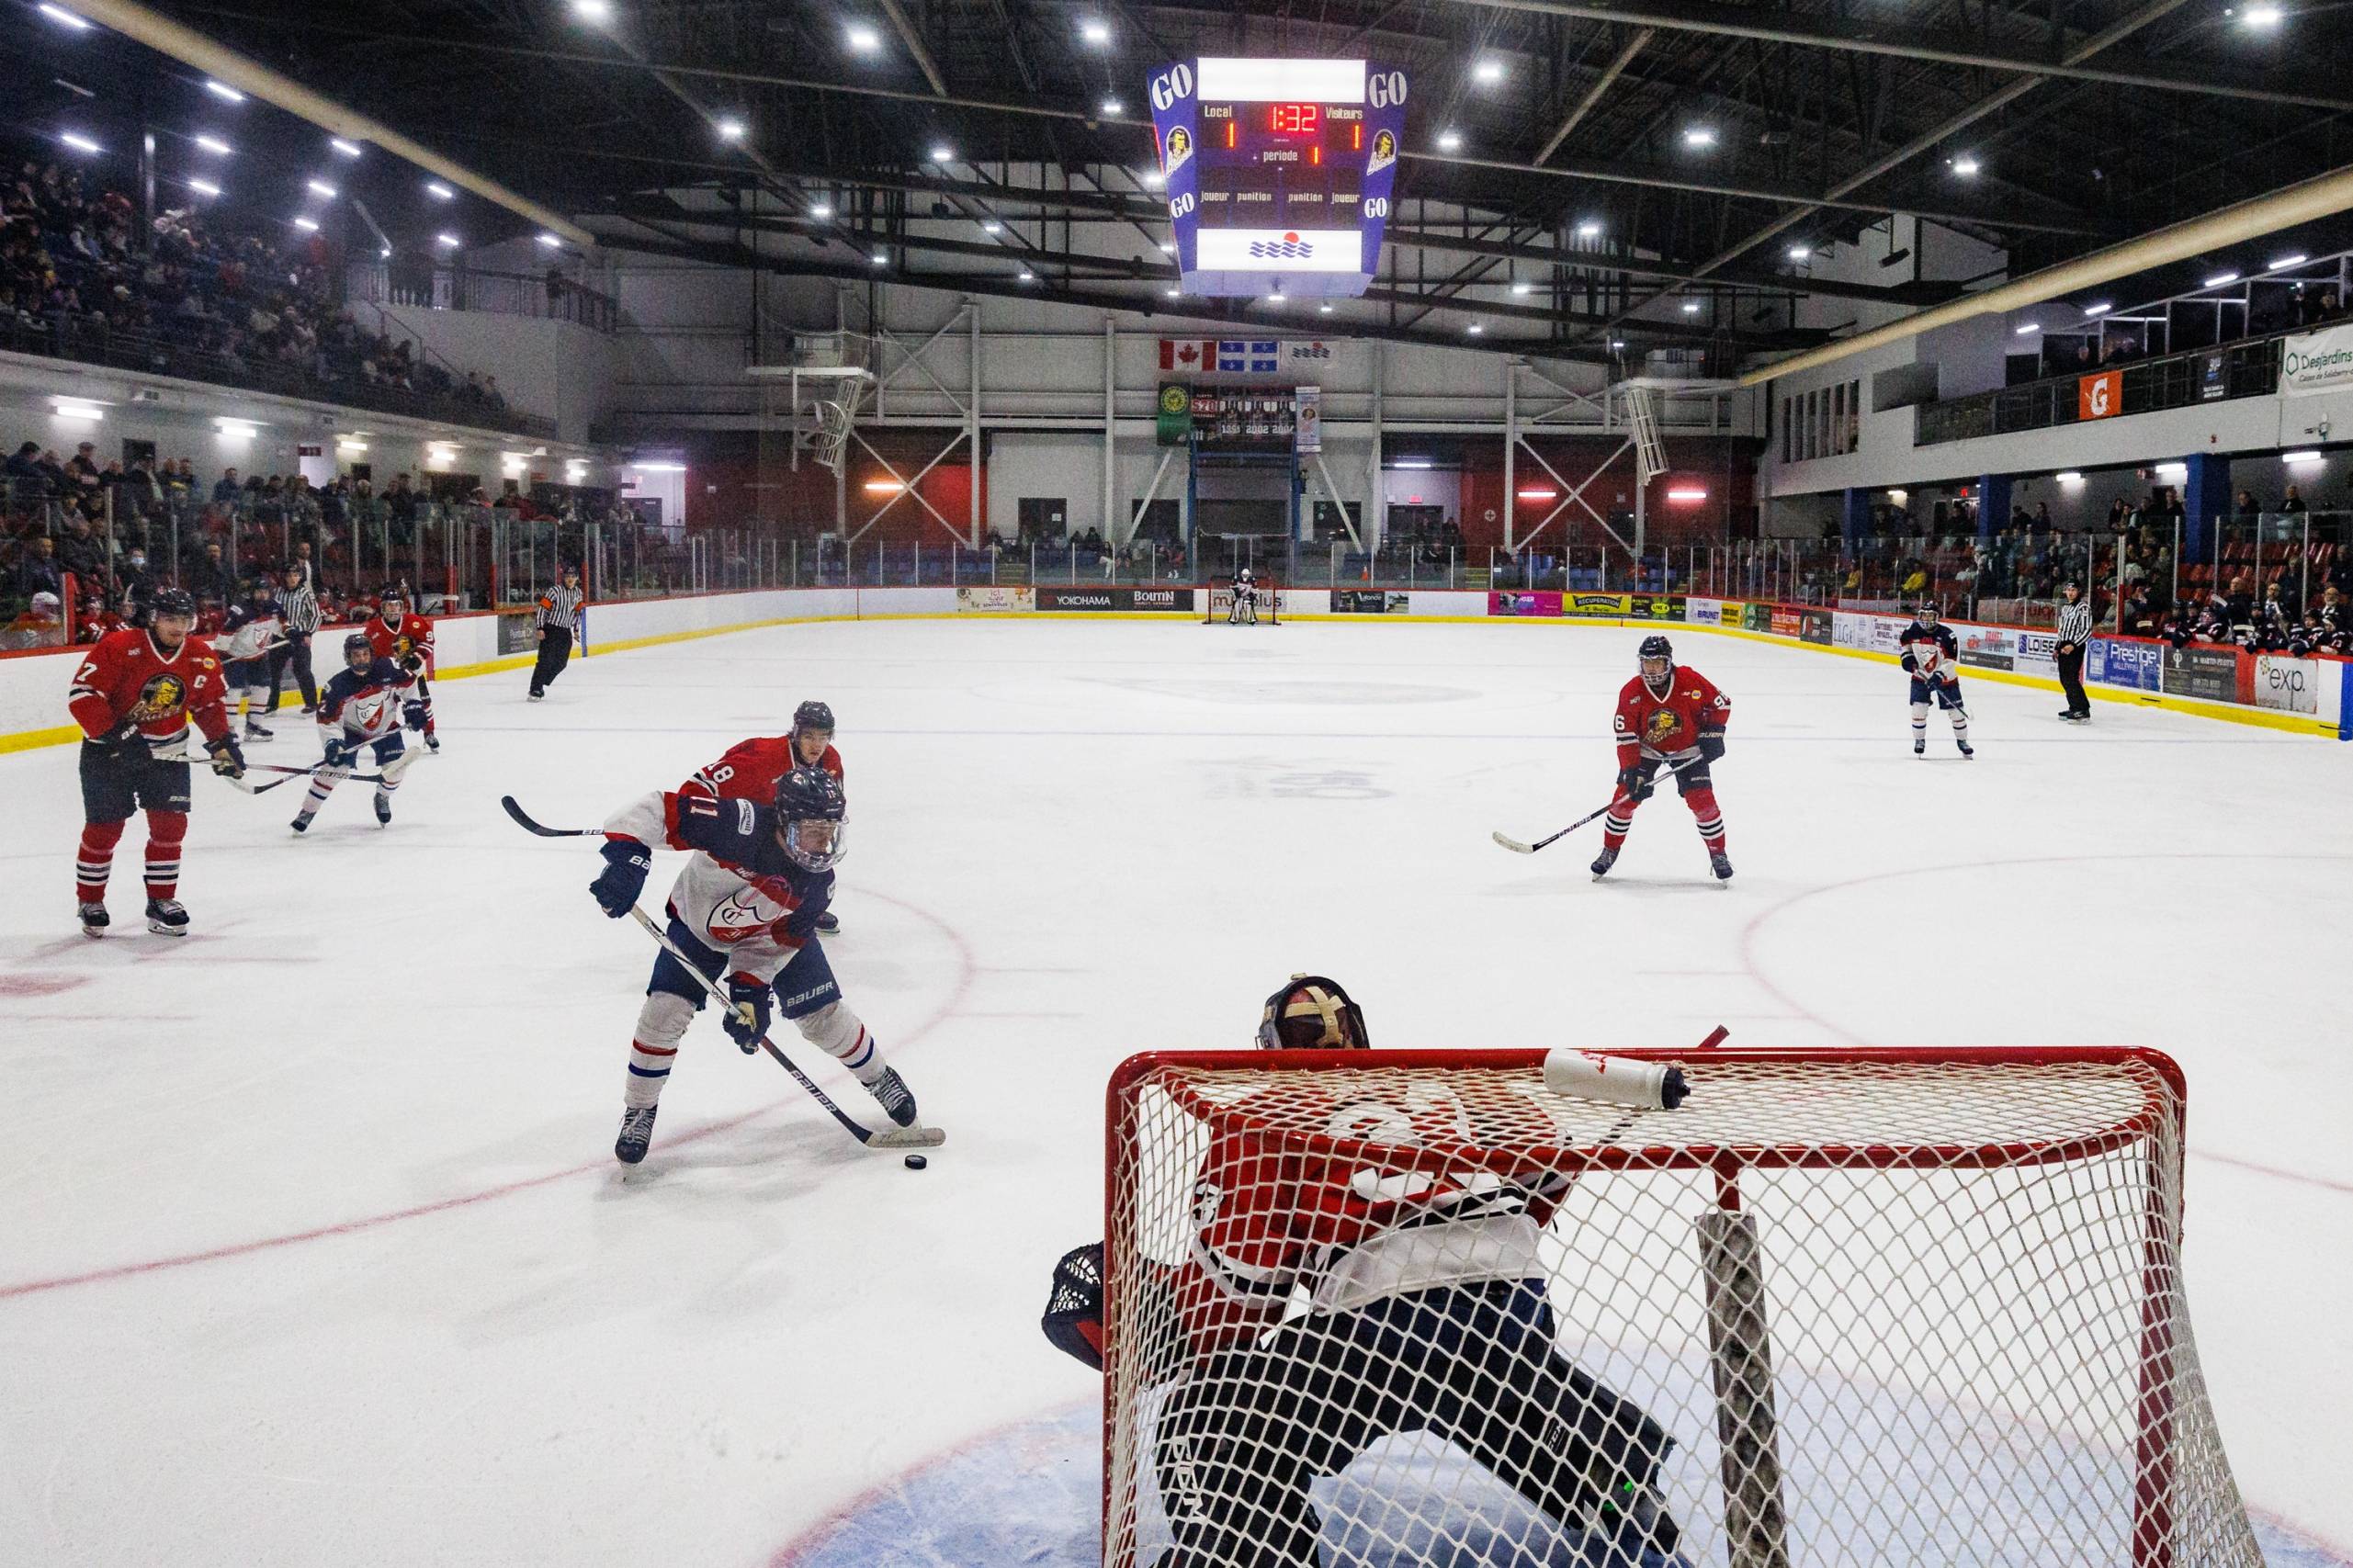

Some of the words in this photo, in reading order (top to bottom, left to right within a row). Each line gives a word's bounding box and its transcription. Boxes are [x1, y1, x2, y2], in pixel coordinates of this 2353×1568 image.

[1152, 63, 1193, 110] GO
[1369, 72, 1407, 108] GO
[1205, 106, 1232, 118] Local
[1273, 106, 1317, 131] 1:32
[1326, 107, 1363, 119] Visiteurs
[1228, 122, 1234, 148] 1
[1354, 124, 1360, 149] 1
[1171, 193, 1194, 218] GO
[1201, 192, 1228, 202] joueur
[1238, 192, 1272, 202] punition
[1288, 192, 1323, 202] punition
[1330, 193, 1360, 204] joueur
[1364, 197, 1387, 218] GO
[2302, 349, 2353, 370] Desjardins
[2091, 378, 2108, 415] G
[1057, 596, 1111, 605] YOKOHAMA
[1697, 610, 1720, 619] BRUNET
[2029, 638, 2056, 653] LOISE
[2110, 644, 2156, 666] Prestige
[194, 674, 208, 689] C
[2269, 668, 2305, 692] exp.
[691, 795, 718, 817] 11
[787, 981, 833, 1008] BAUER
[791, 1069, 837, 1113] BAUER
